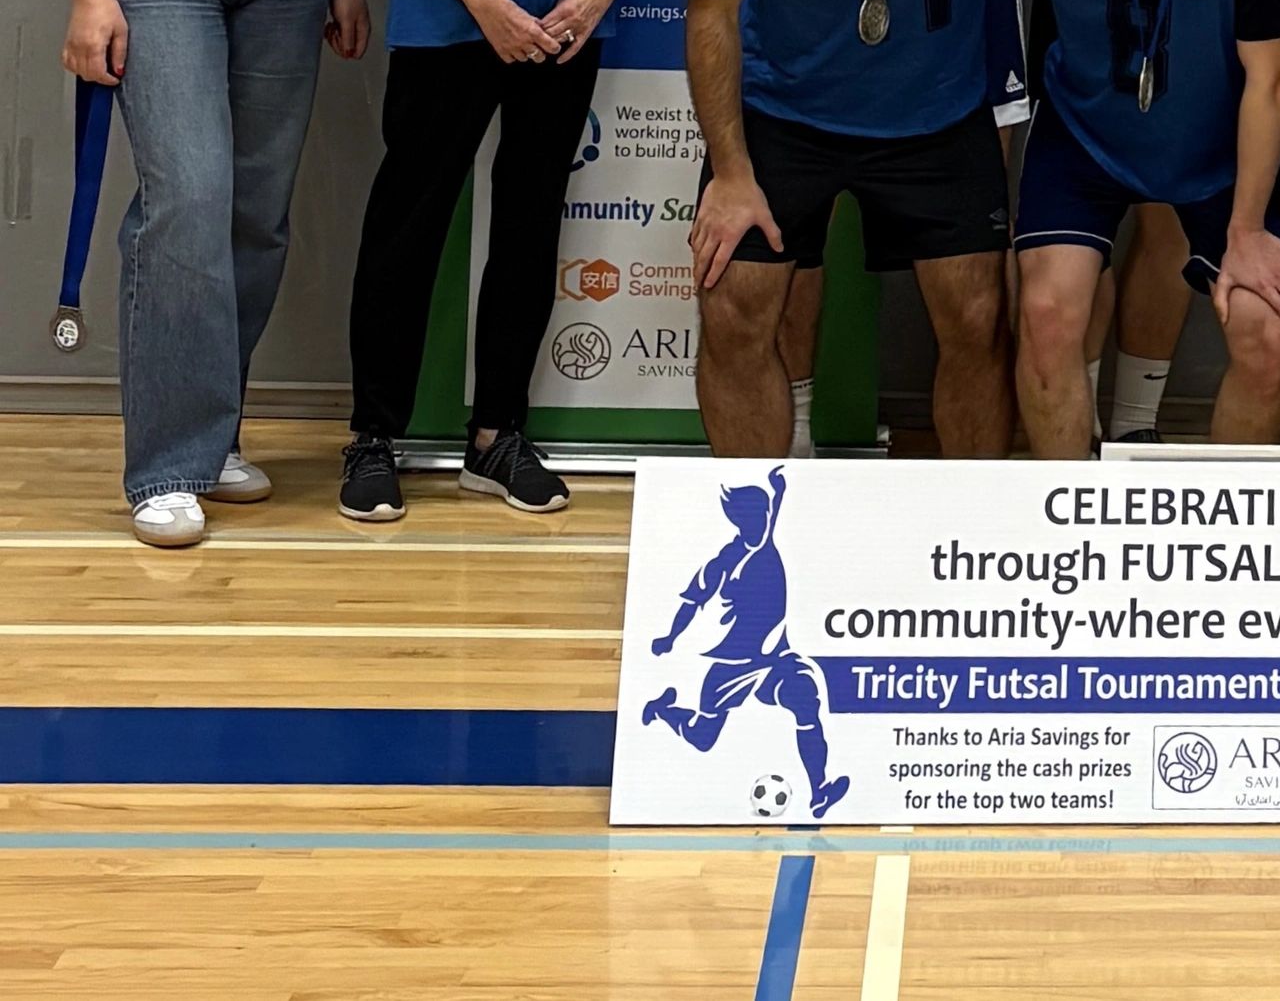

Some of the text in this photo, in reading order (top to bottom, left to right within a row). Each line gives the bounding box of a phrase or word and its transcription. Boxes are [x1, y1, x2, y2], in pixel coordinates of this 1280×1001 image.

[615, 105, 641, 121] We
[645, 107, 682, 121] exist
[615, 125, 681, 143] working
[615, 144, 631, 157] to
[635, 143, 676, 158] build
[680, 147, 689, 159] a
[621, 328, 698, 360] ARI
[931, 540, 1106, 595] through
[824, 597, 1225, 651] community-where
[851, 664, 959, 709] Tricity
[968, 664, 1068, 699] Futsal
[892, 727, 1131, 751] Thanks to Aria Savings for
[889, 758, 1132, 782] sponsoring the cash prizes
[904, 790, 1114, 814] for the top two teams!
